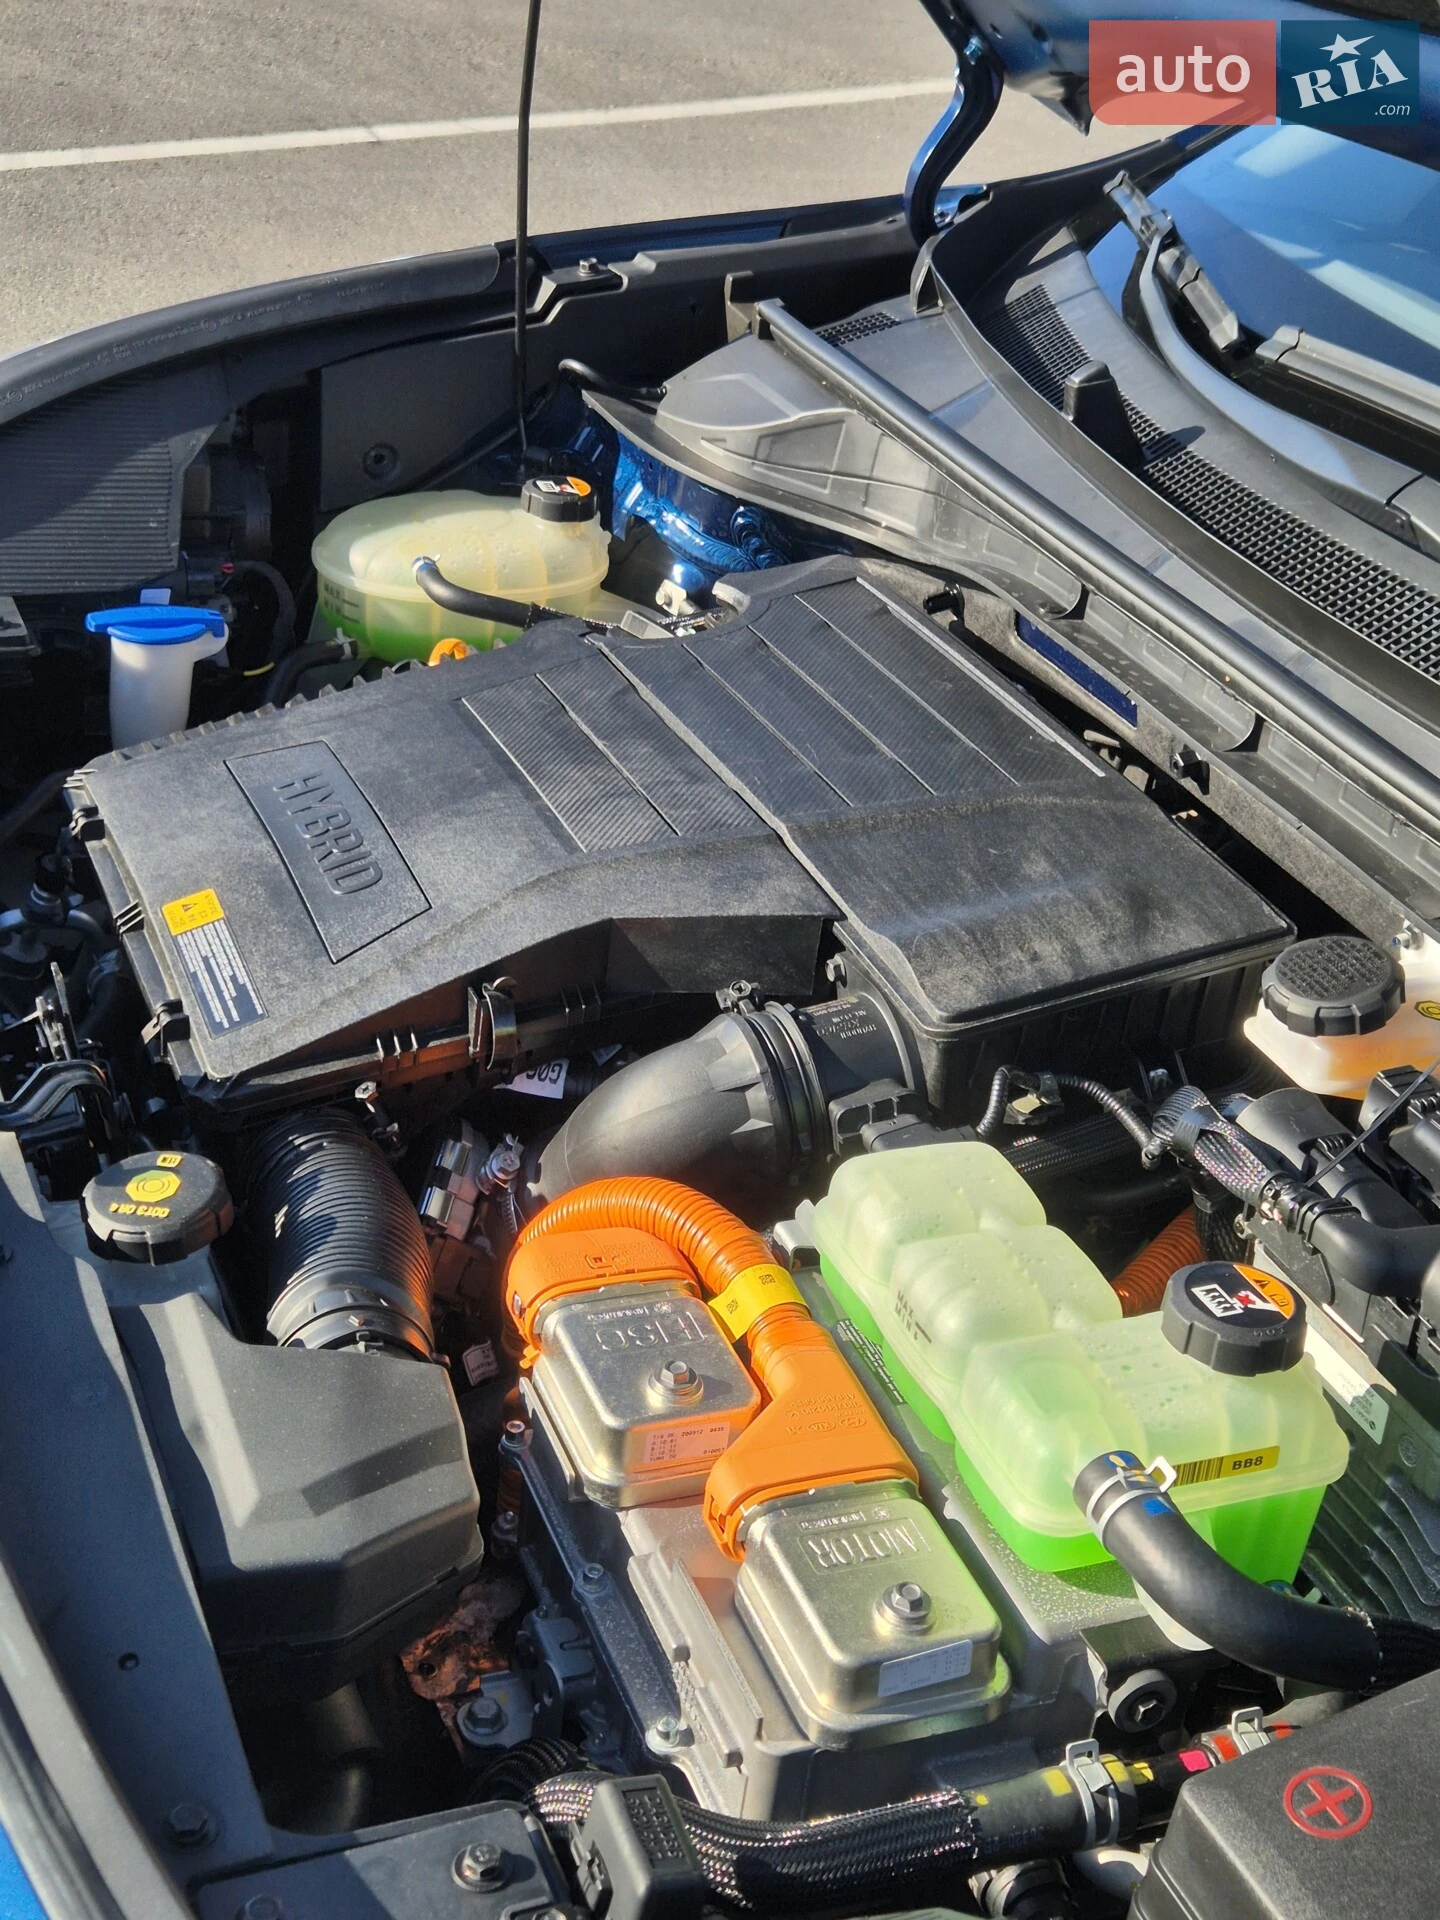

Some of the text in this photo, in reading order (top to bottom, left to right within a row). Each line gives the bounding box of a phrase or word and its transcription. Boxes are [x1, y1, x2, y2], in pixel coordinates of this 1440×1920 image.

[273, 771, 383, 895] HYBRID
[109, 1202, 170, 1218] DOT3 OR 4
[895, 1301, 912, 1332] MIN
[897, 1289, 914, 1320] MAX
[1232, 1455, 1264, 1471] BB8
[808, 1525, 920, 1567] MOTOR
